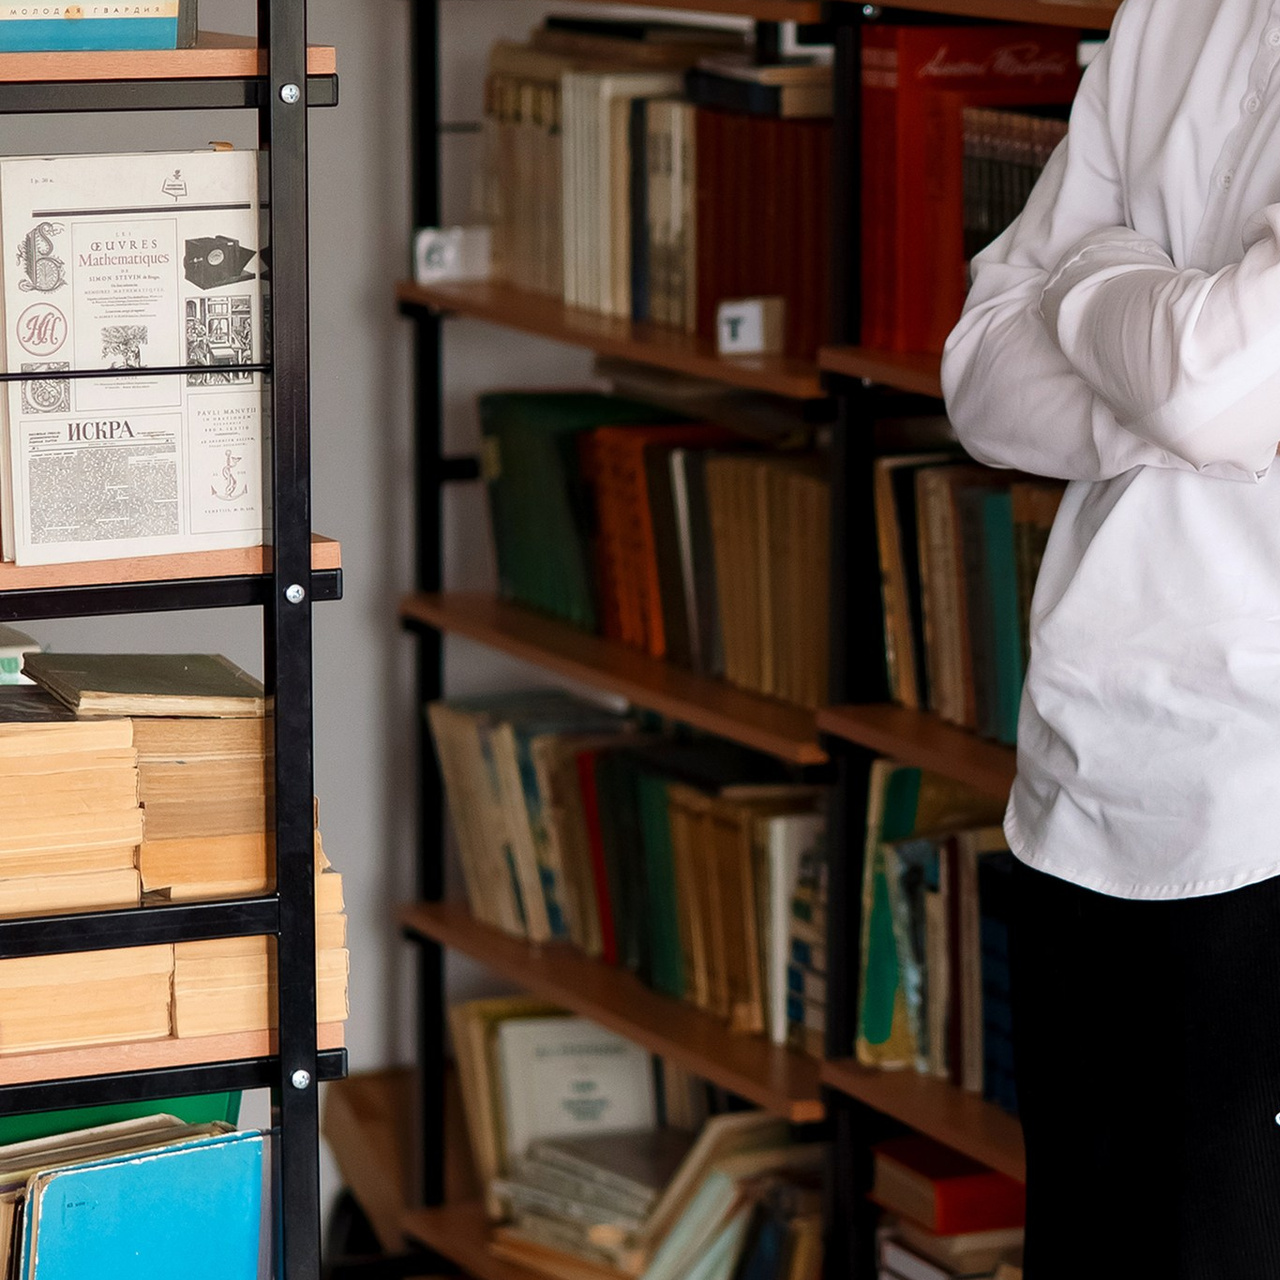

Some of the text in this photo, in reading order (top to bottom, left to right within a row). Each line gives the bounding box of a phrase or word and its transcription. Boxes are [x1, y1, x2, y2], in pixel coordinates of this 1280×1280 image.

[10, 6, 160, 16] МОЛОДАЯ ГВАРДИЯ
[90, 239, 158, 252] ŒUVRES
[78, 251, 170, 268] Mathematiques
[68, 420, 135, 442] ИСКРА
